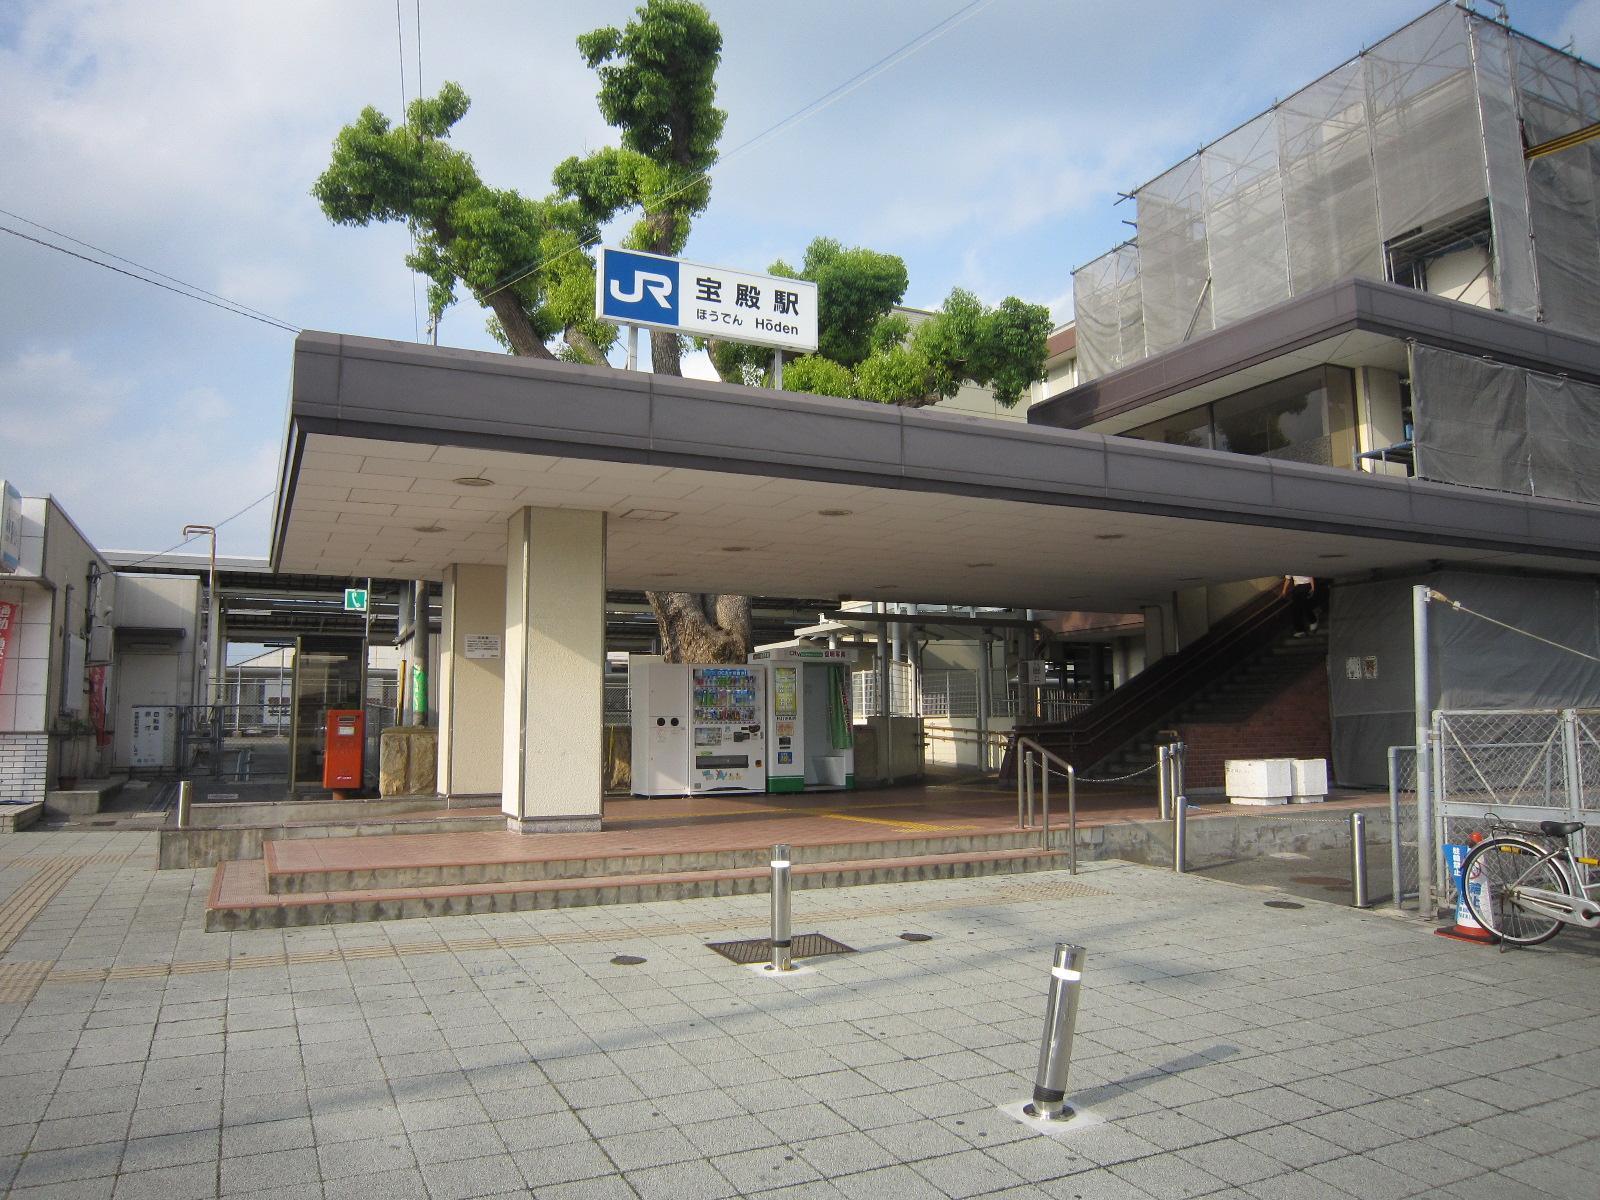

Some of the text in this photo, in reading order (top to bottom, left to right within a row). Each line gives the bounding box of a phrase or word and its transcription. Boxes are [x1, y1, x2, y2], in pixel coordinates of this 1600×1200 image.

[610, 270, 672, 309] JR
[695, 276, 799, 316] 宝殿駅
[696, 308, 799, 335] ほうでん Hōden
